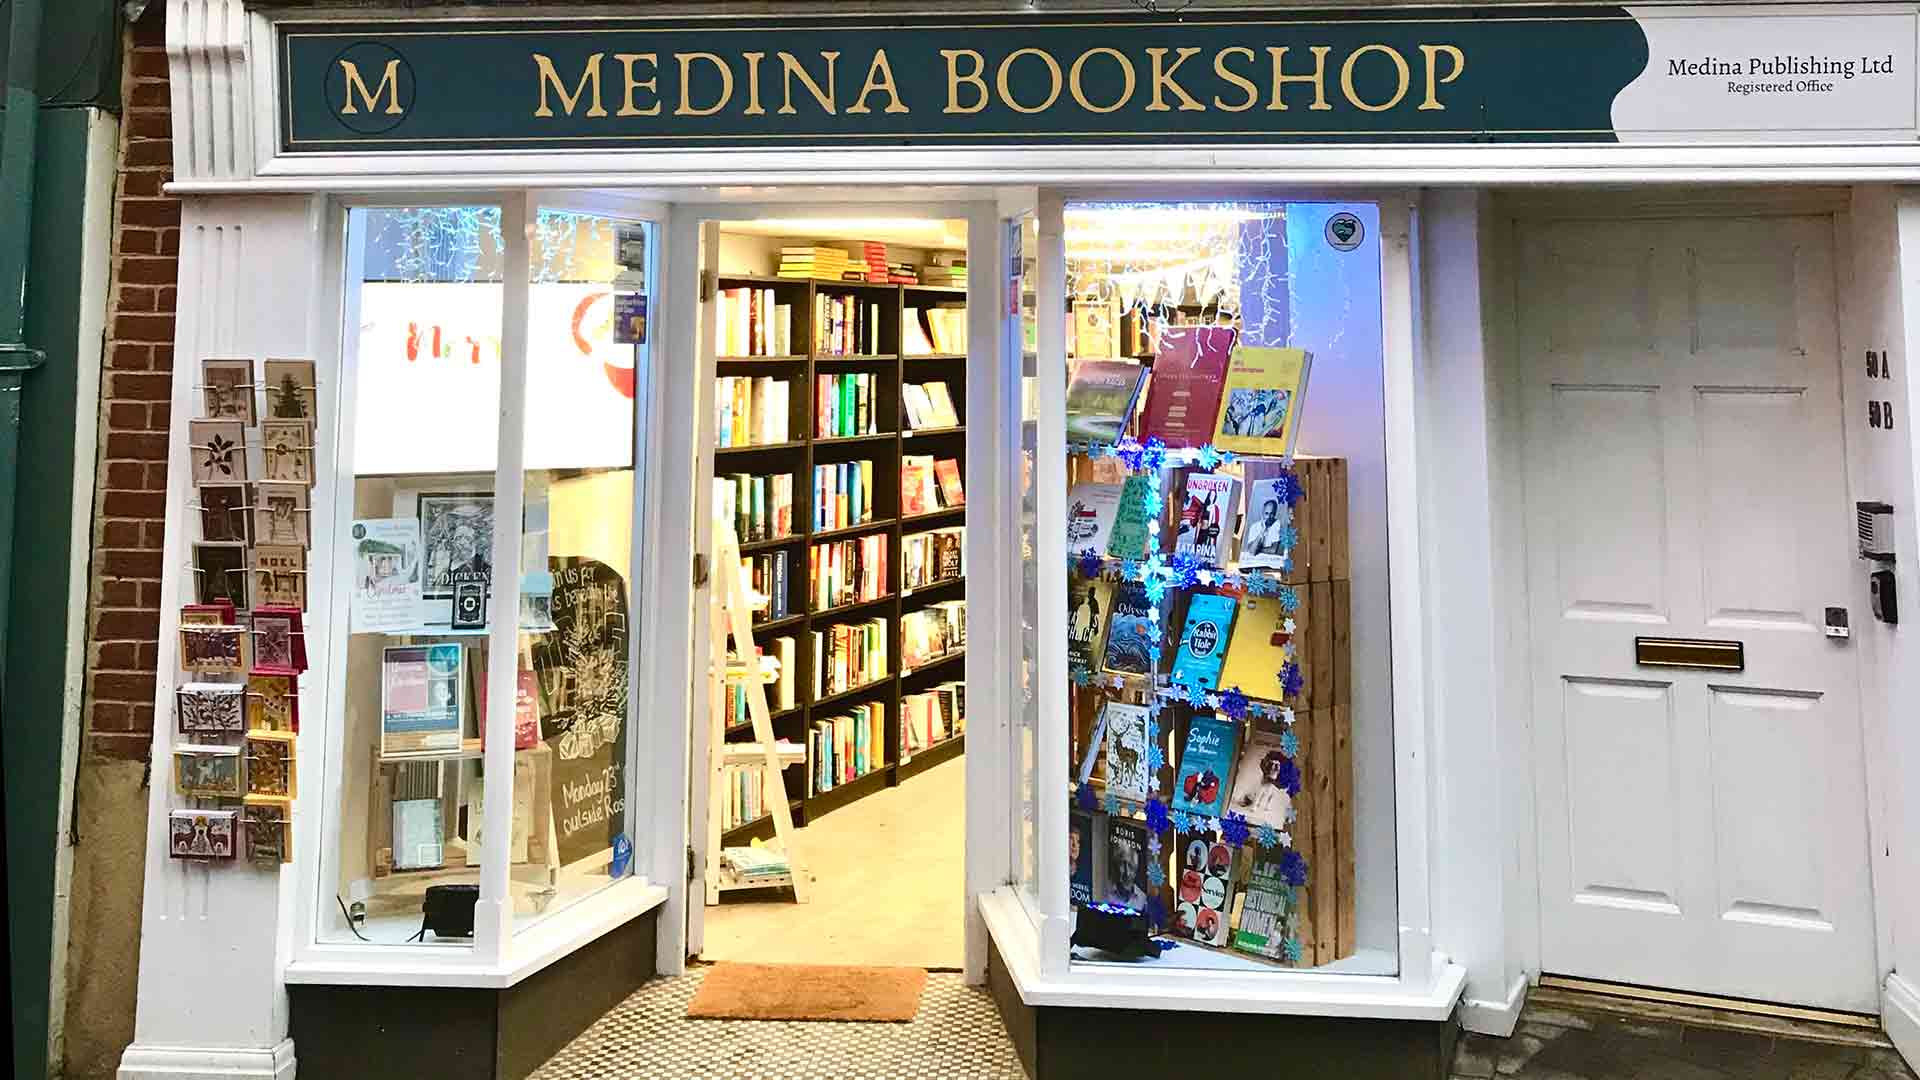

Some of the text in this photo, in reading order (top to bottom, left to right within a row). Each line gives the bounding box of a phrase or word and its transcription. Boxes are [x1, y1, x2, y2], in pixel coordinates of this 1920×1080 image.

[1668, 54, 1894, 79] Medina Publishing Ltd
[340, 60, 402, 115] M
[533, 44, 1465, 117] MEDINA BOOKSHOP
[1727, 80, 1833, 96] Registered Office
[1883, 401, 1893, 429] B
[1178, 543, 1216, 559] ATARINA
[260, 557, 297, 567] NOEL
[440, 571, 491, 585] DICKEN
[1188, 727, 1220, 747] Sophie
[562, 773, 603, 809] Monday
[1115, 826, 1136, 839] BORIS
